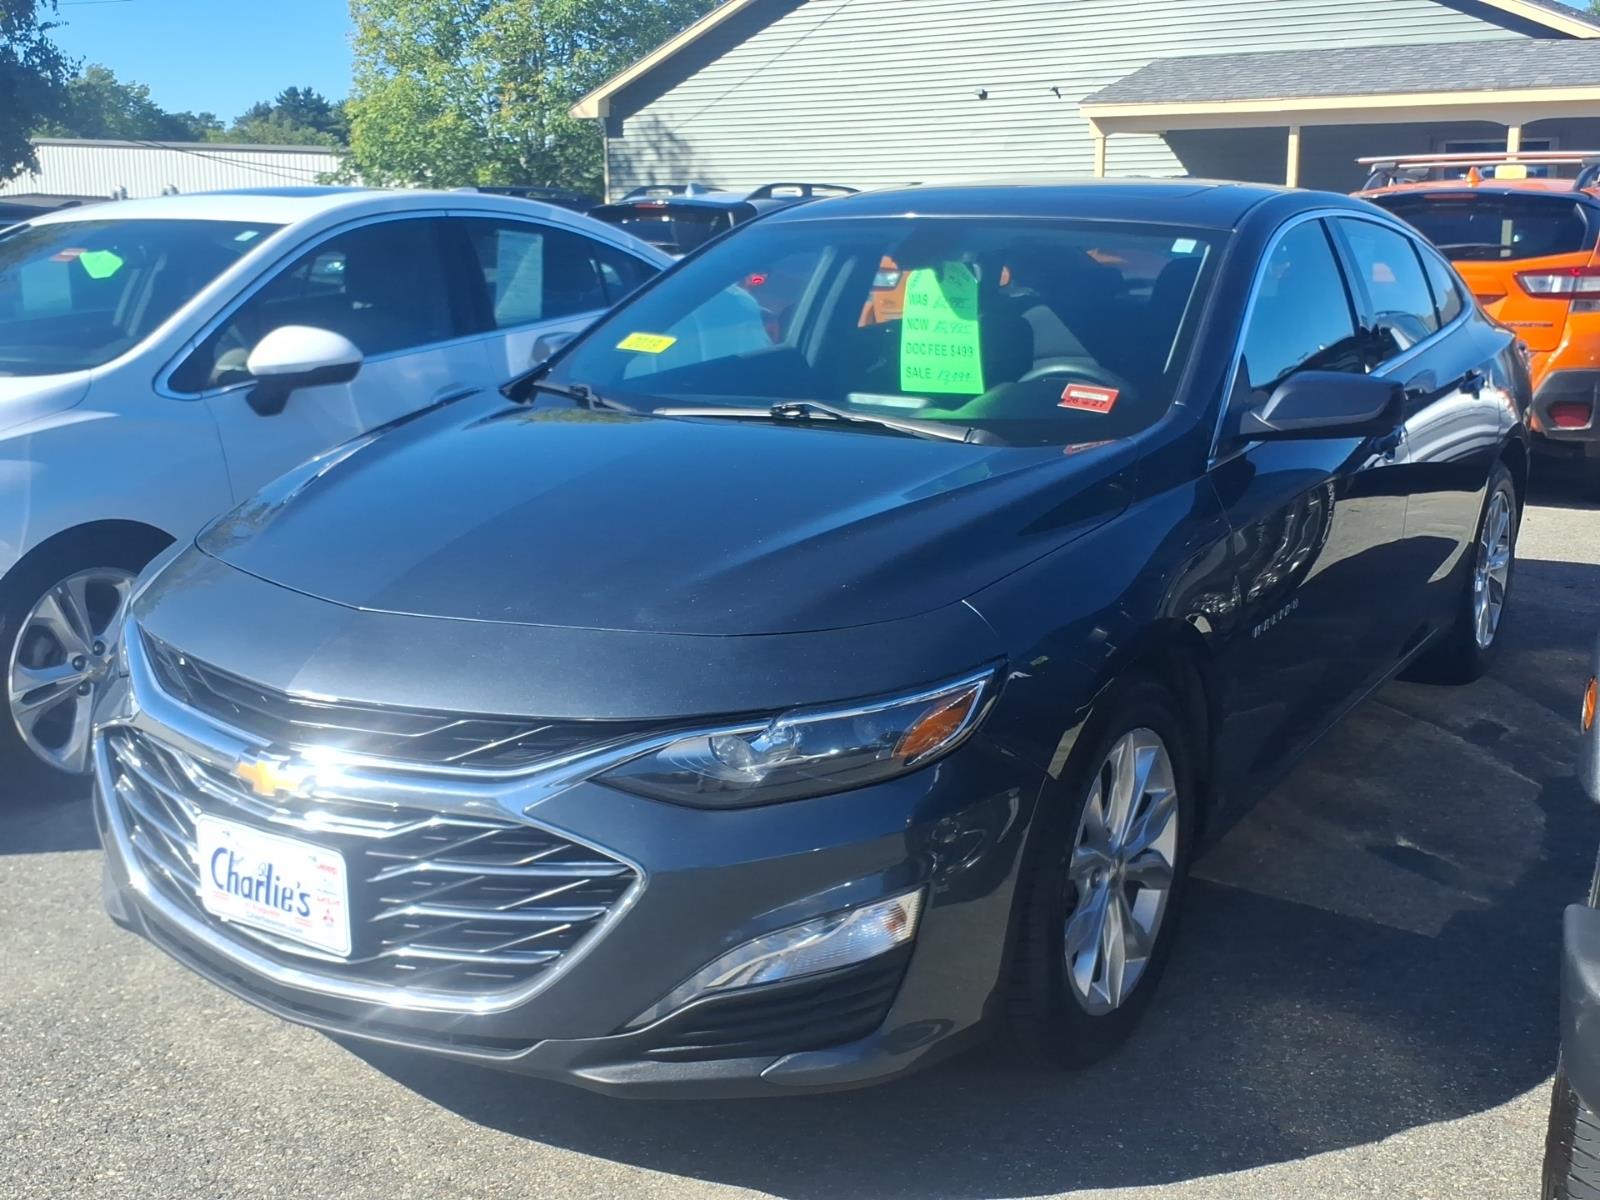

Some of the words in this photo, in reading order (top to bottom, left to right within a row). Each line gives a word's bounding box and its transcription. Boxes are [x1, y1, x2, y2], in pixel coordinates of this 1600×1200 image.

[909, 294, 928, 306] WAS
[907, 318, 929, 331] NOW
[905, 342, 926, 356] DOC
[928, 344, 948, 357] FEE
[950, 344, 974, 358] $499
[905, 366, 931, 379] SALE
[210, 846, 311, 918] Charlie's
